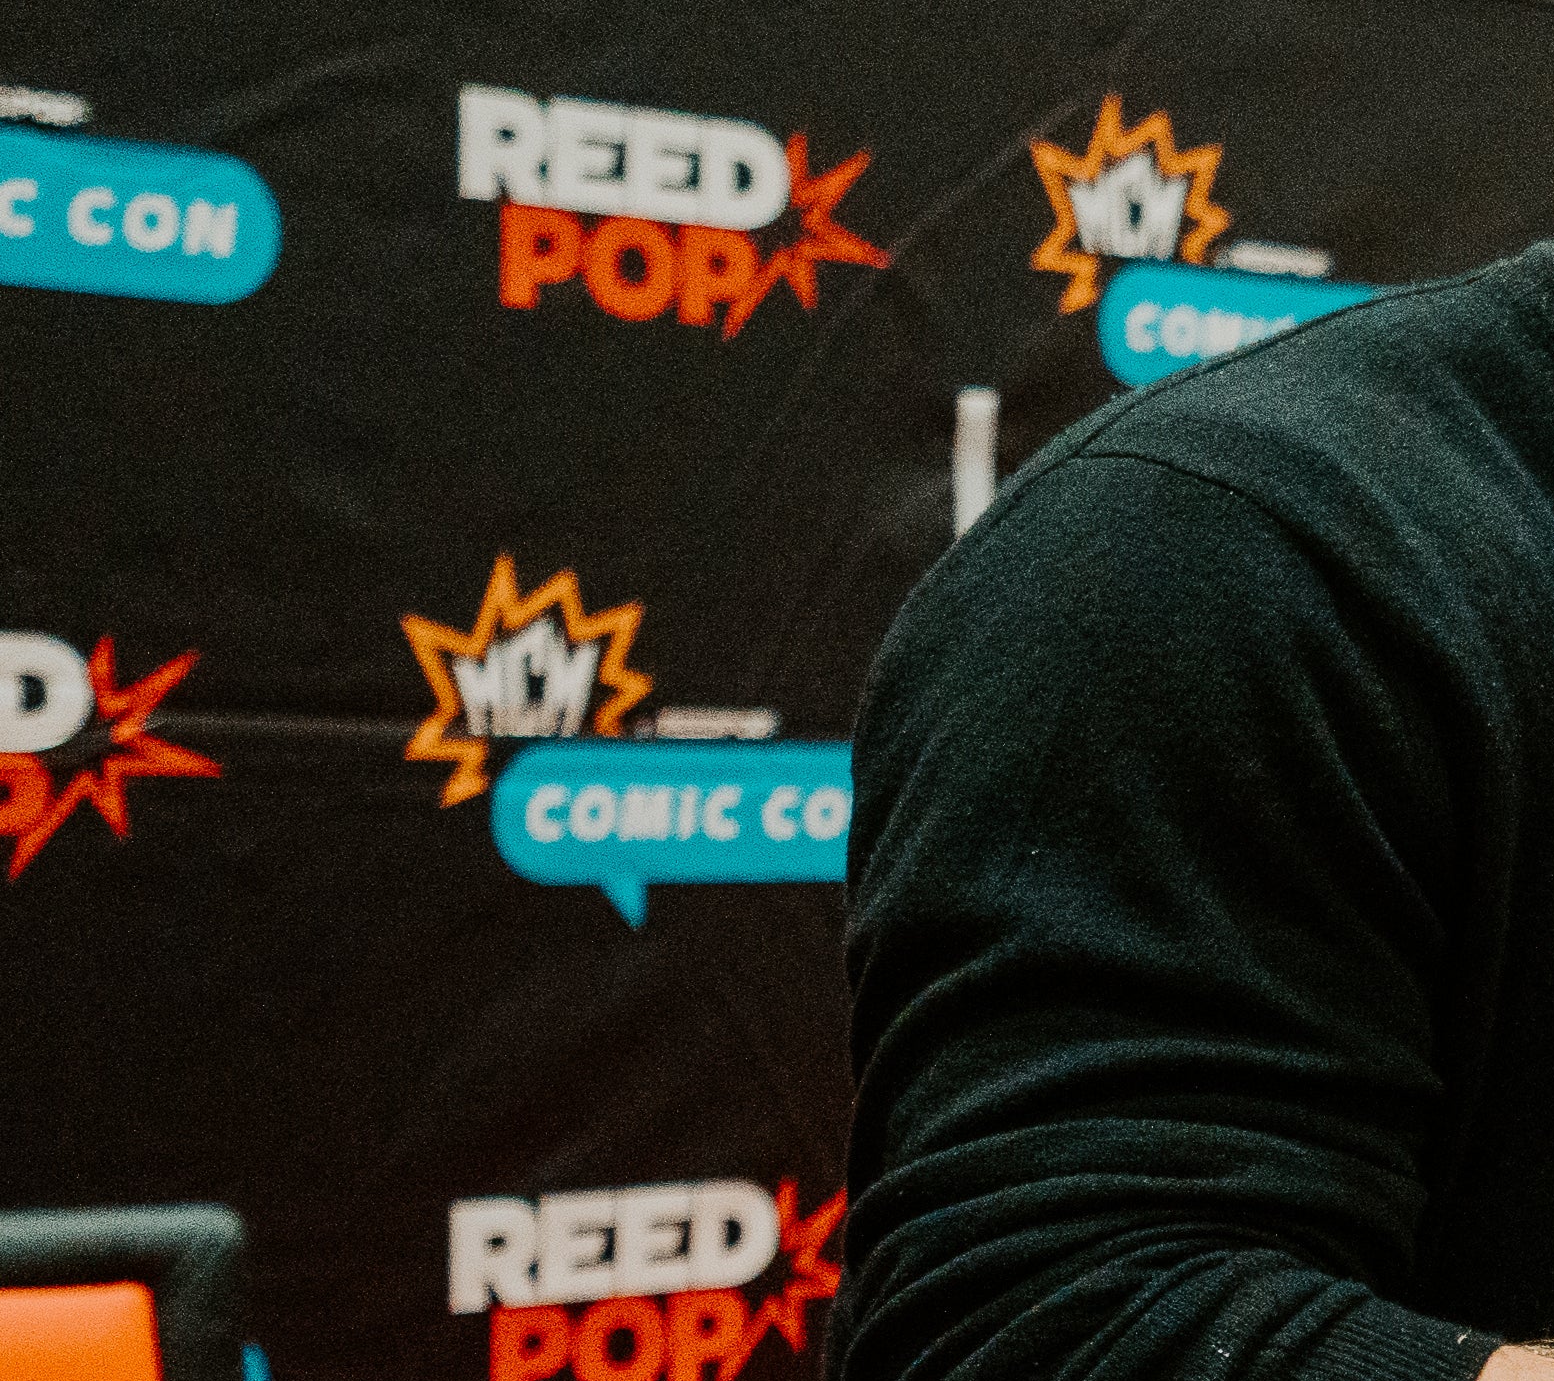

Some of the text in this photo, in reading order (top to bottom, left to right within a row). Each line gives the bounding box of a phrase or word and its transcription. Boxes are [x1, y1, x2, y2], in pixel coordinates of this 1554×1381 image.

[455, 81, 792, 234] REED
[66, 185, 240, 260] CON
[498, 201, 762, 329] POP
[524, 783, 853, 844] COMIC CO
[448, 1176, 781, 1315] REED
